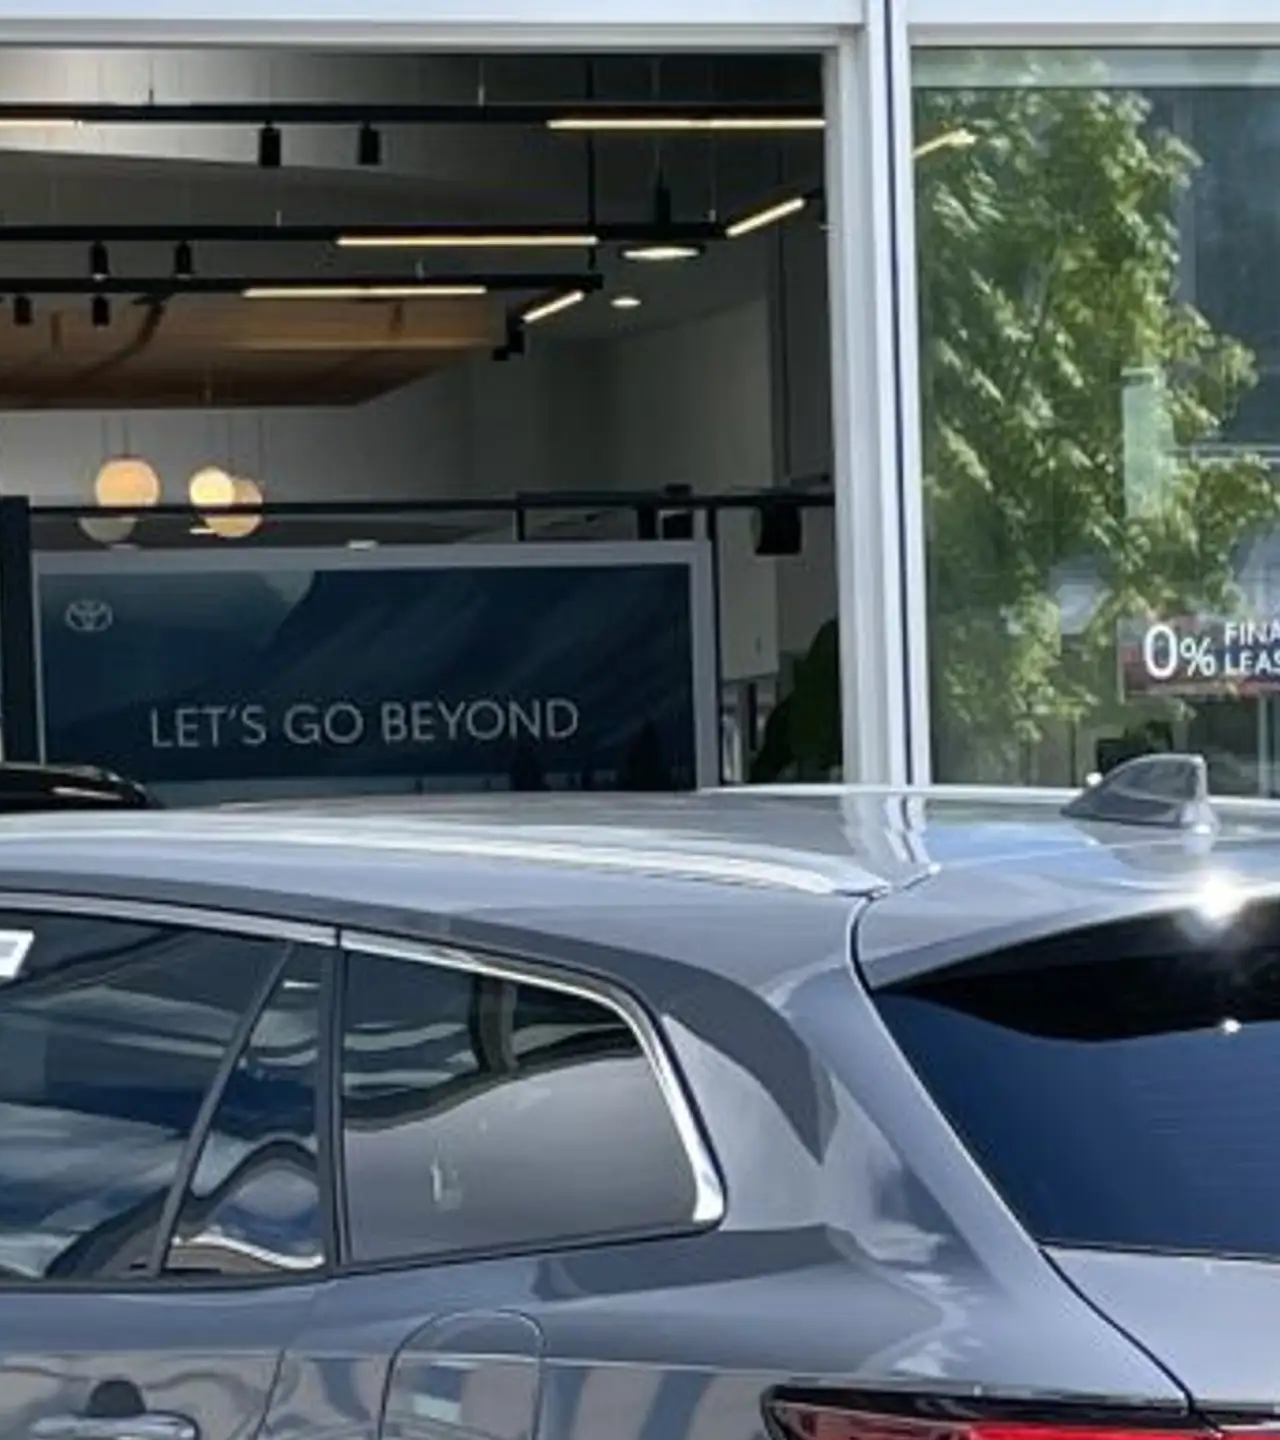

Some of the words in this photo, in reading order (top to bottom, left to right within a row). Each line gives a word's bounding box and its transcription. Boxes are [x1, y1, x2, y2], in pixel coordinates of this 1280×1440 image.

[1143, 624, 1216, 678] 0%
[151, 706, 267, 748] LET'S
[283, 703, 365, 745] GO
[381, 699, 579, 742] BEYOND
